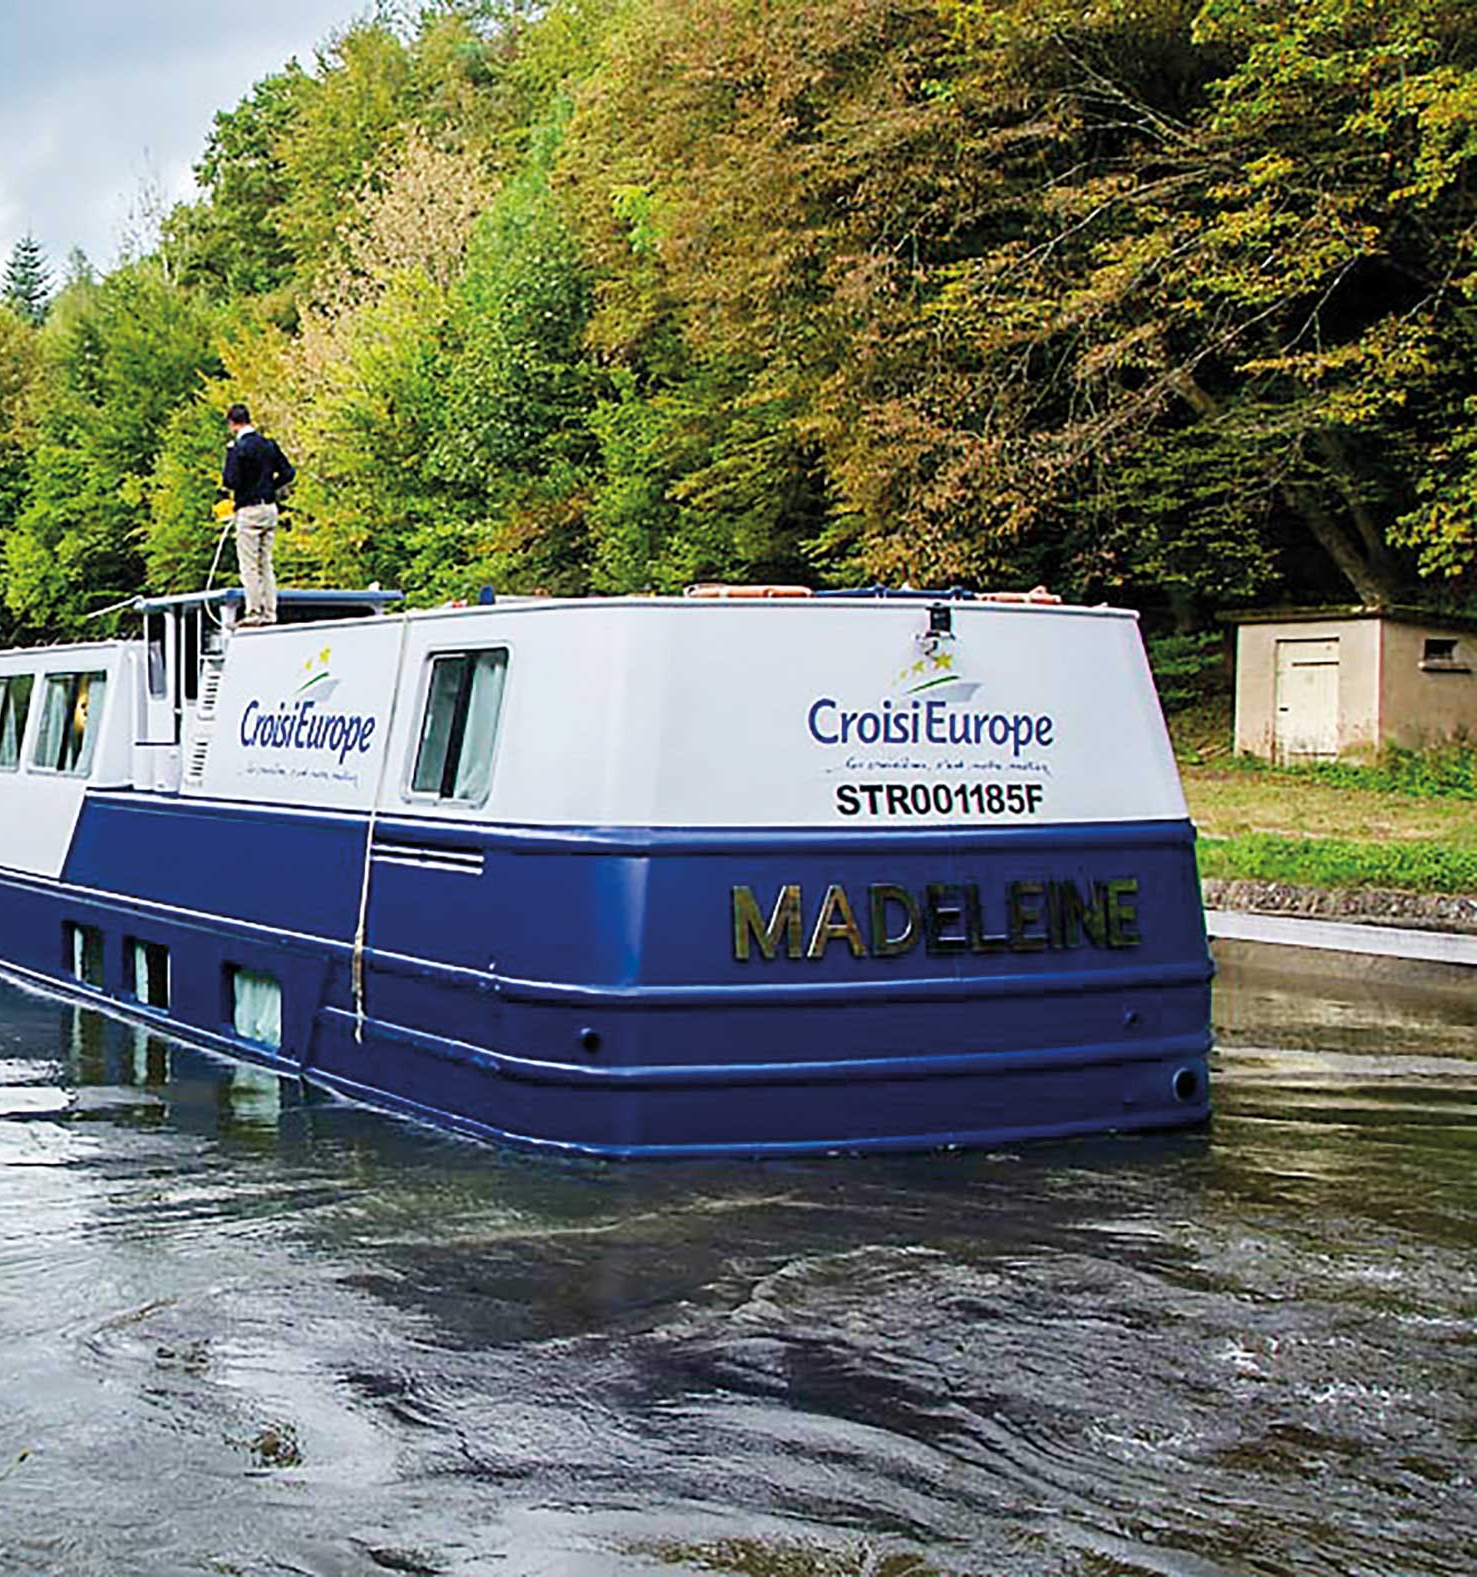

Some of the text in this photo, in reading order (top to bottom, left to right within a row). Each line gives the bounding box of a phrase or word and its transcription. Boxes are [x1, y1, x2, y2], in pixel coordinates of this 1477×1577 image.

[240, 700, 376, 765] CroisiEurope
[808, 698, 1054, 757] CroisiEurope
[836, 783, 1043, 815] STR001185F
[730, 878, 1141, 960] MADELEINE
